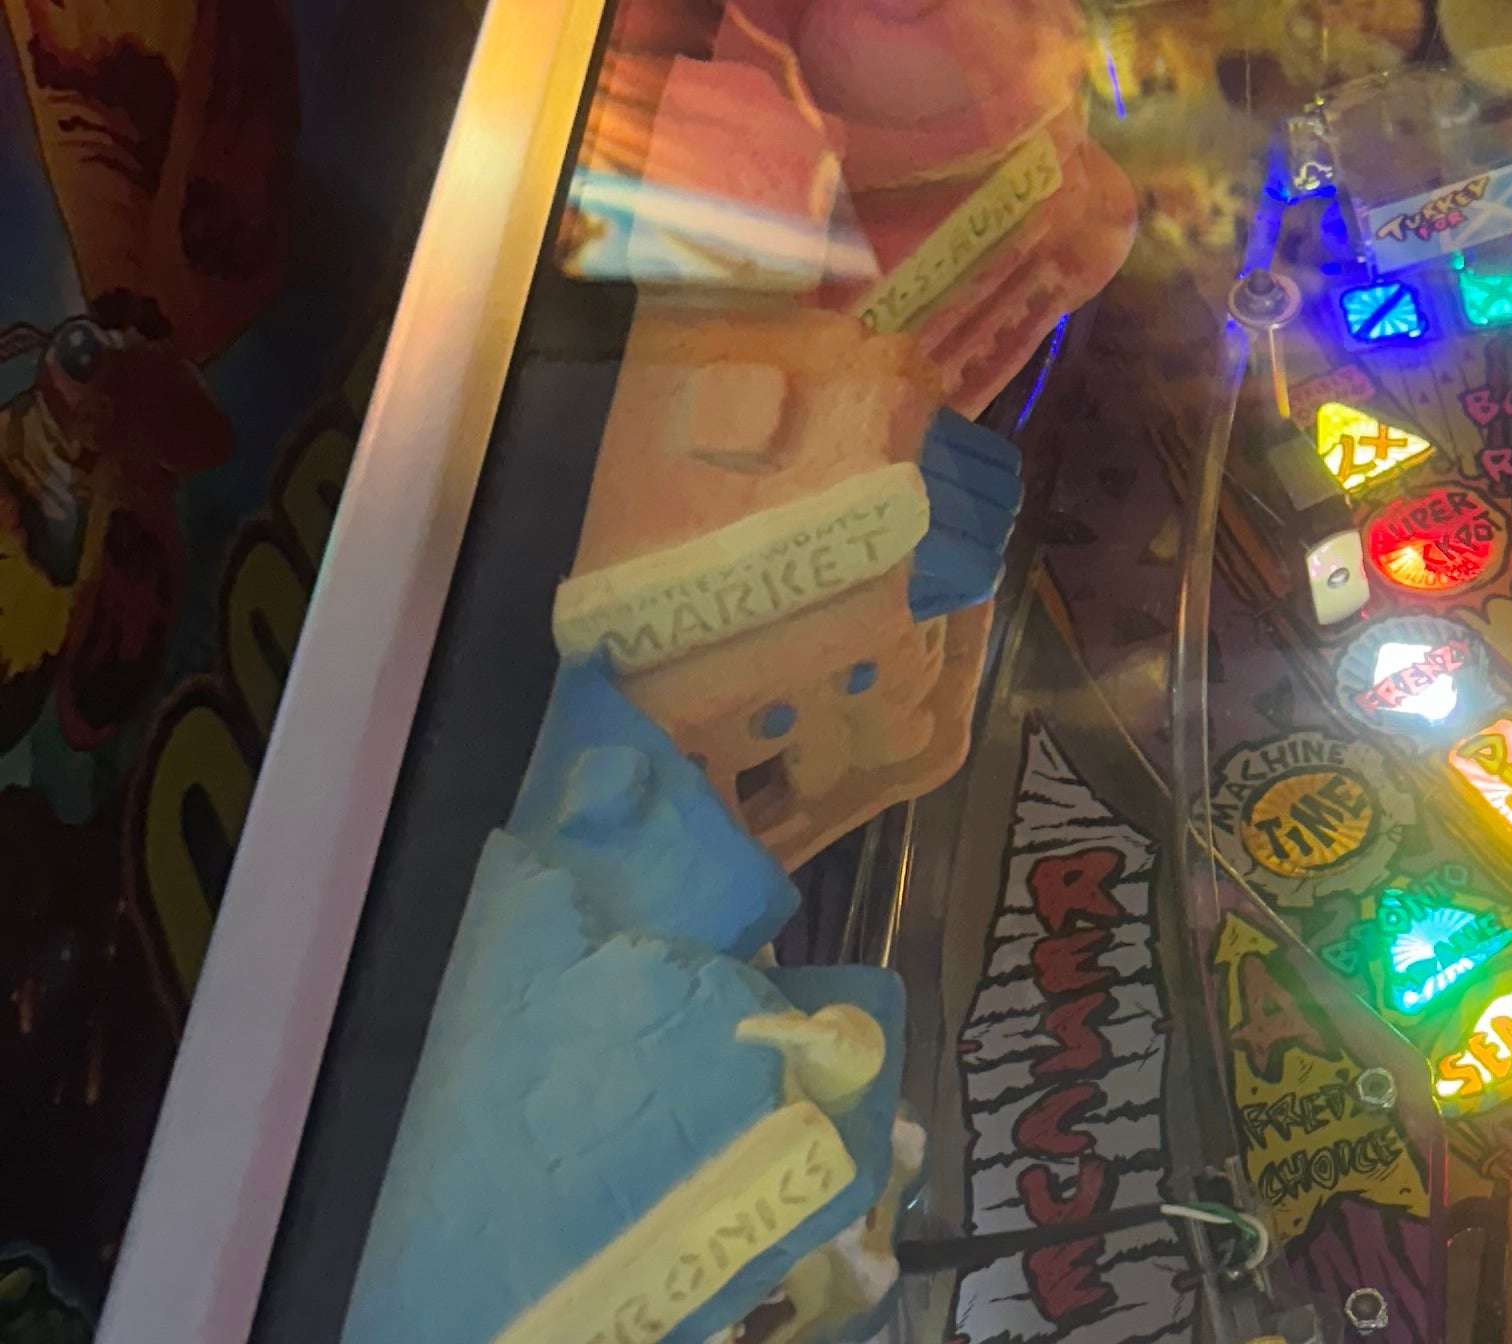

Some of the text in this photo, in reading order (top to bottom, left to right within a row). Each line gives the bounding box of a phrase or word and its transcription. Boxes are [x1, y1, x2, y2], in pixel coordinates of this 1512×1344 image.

[598, 528, 888, 656] MARKET
[1209, 739, 1345, 836] MACHINE
[1254, 774, 1371, 861] TIME
[1012, 849, 1124, 1322] RESCUE
[1260, 1125, 1404, 1206] CHOICE
